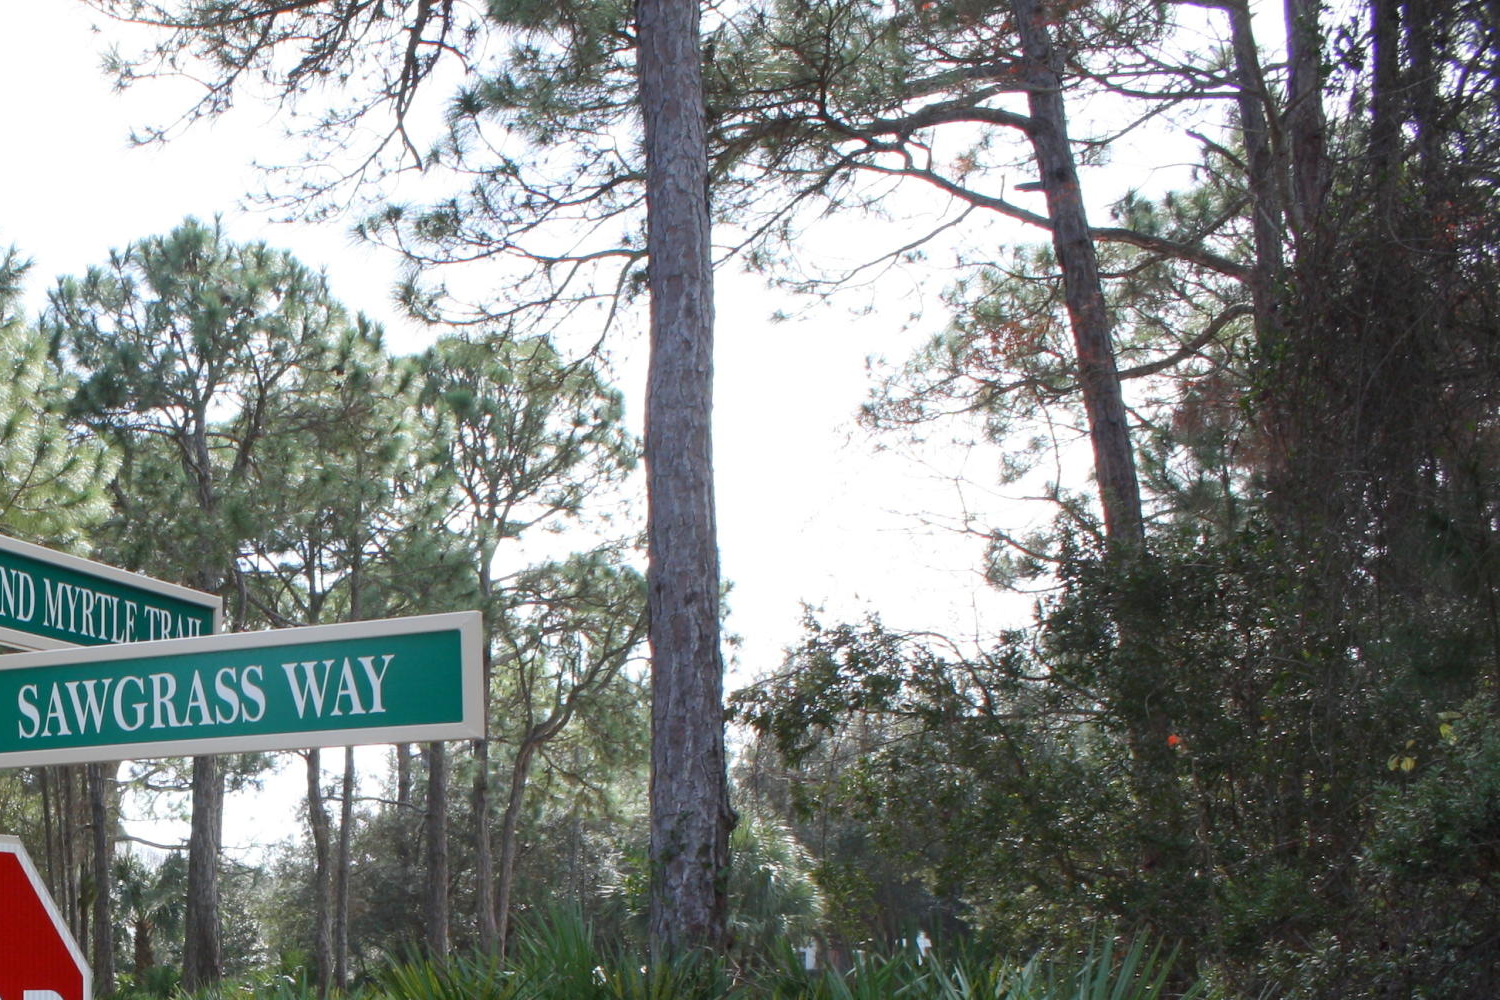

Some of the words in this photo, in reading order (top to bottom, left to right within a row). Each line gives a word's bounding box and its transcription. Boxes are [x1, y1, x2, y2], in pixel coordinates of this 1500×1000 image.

[43, 577, 138, 643] MYRTLE
[18, 664, 266, 739] SAWGRASS
[281, 653, 395, 719] WAY
